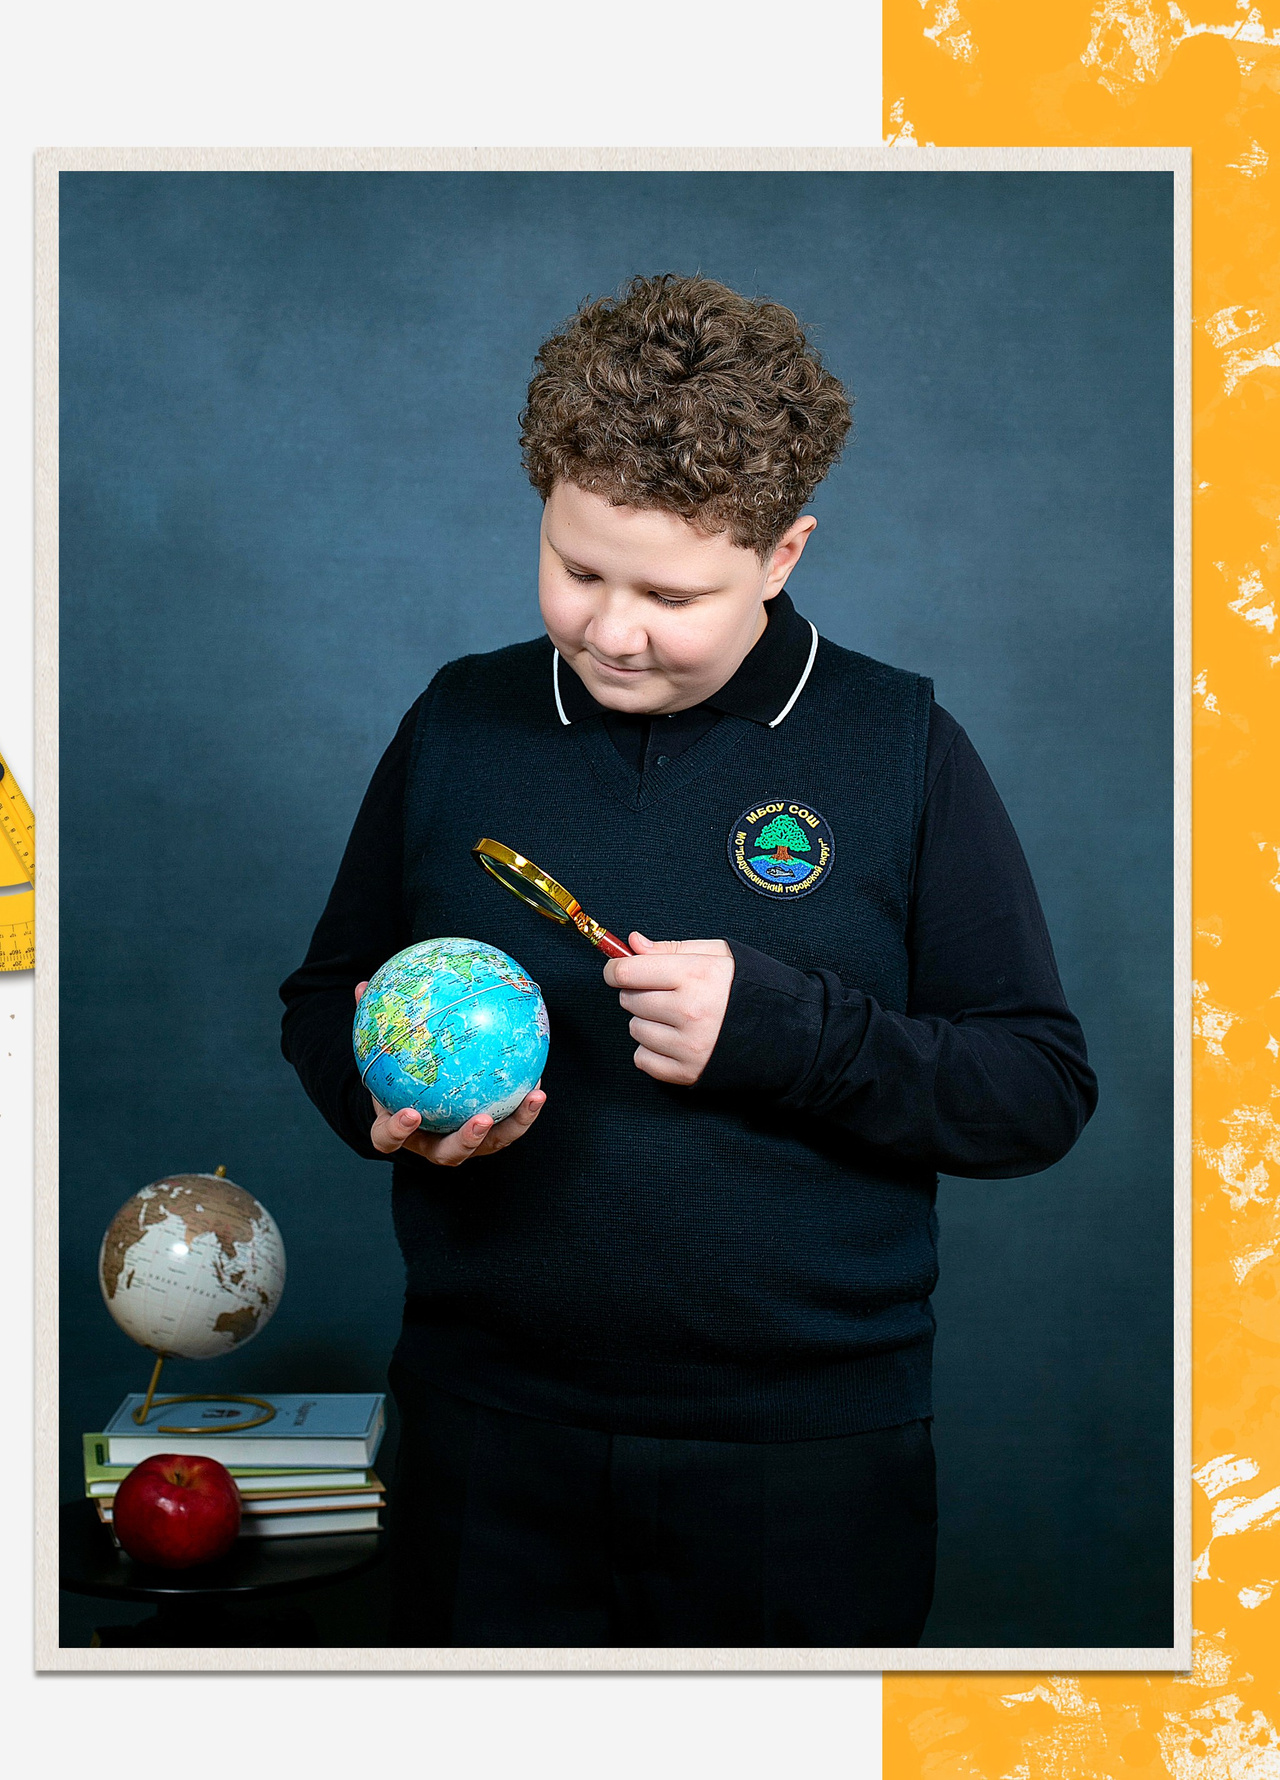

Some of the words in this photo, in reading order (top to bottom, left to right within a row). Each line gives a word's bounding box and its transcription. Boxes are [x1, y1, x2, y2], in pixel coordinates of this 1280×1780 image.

[746, 802, 784, 825] МБОУ
[788, 804, 820, 829] СОШ
[734, 831, 747, 845] МО
[785, 865, 824, 894] городской
